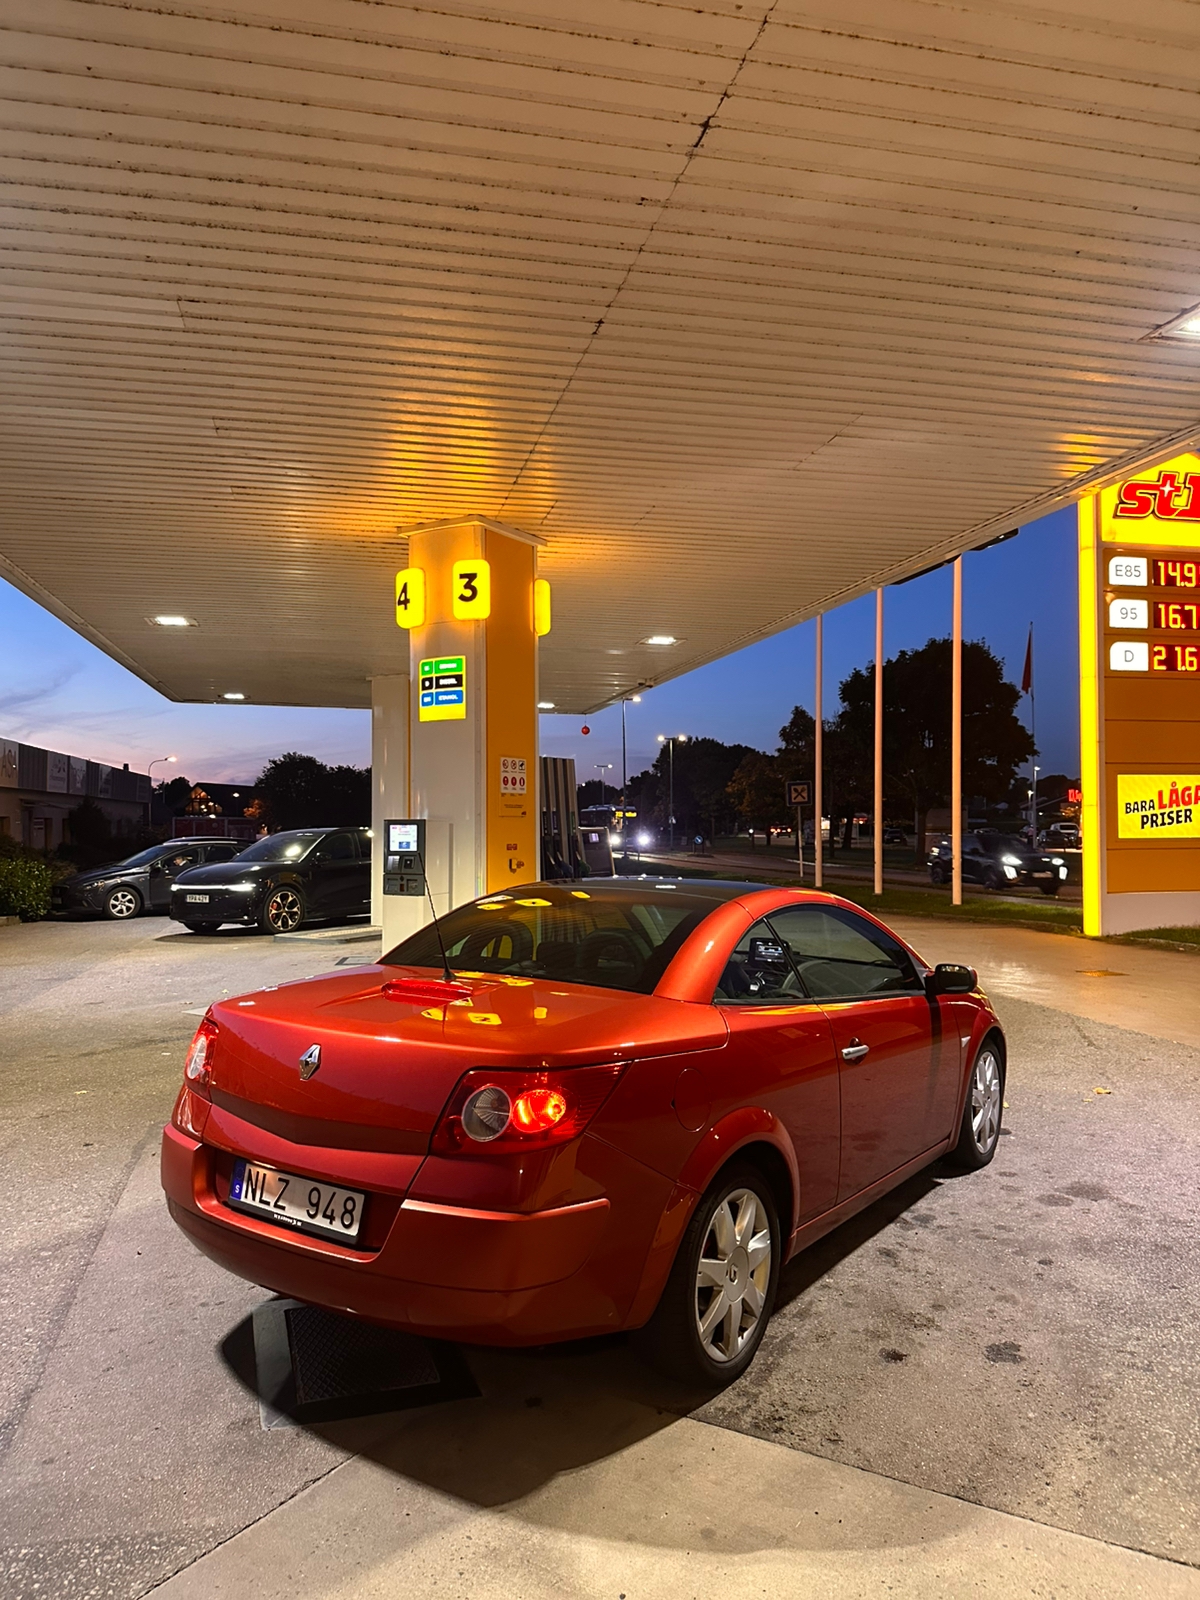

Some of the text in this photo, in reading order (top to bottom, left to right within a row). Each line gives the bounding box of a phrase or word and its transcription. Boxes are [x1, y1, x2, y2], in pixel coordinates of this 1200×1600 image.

[1115, 565, 1141, 577] E85
[458, 573, 478, 602] 3
[397, 582, 410, 610] 4
[1120, 607, 1137, 620] 95
[1124, 650, 1134, 662] D
[1125, 799, 1155, 814] BARA
[1141, 808, 1192, 829] PRISER
[235, 1185, 240, 1193] S
[245, 1168, 356, 1229] NLZ 948
